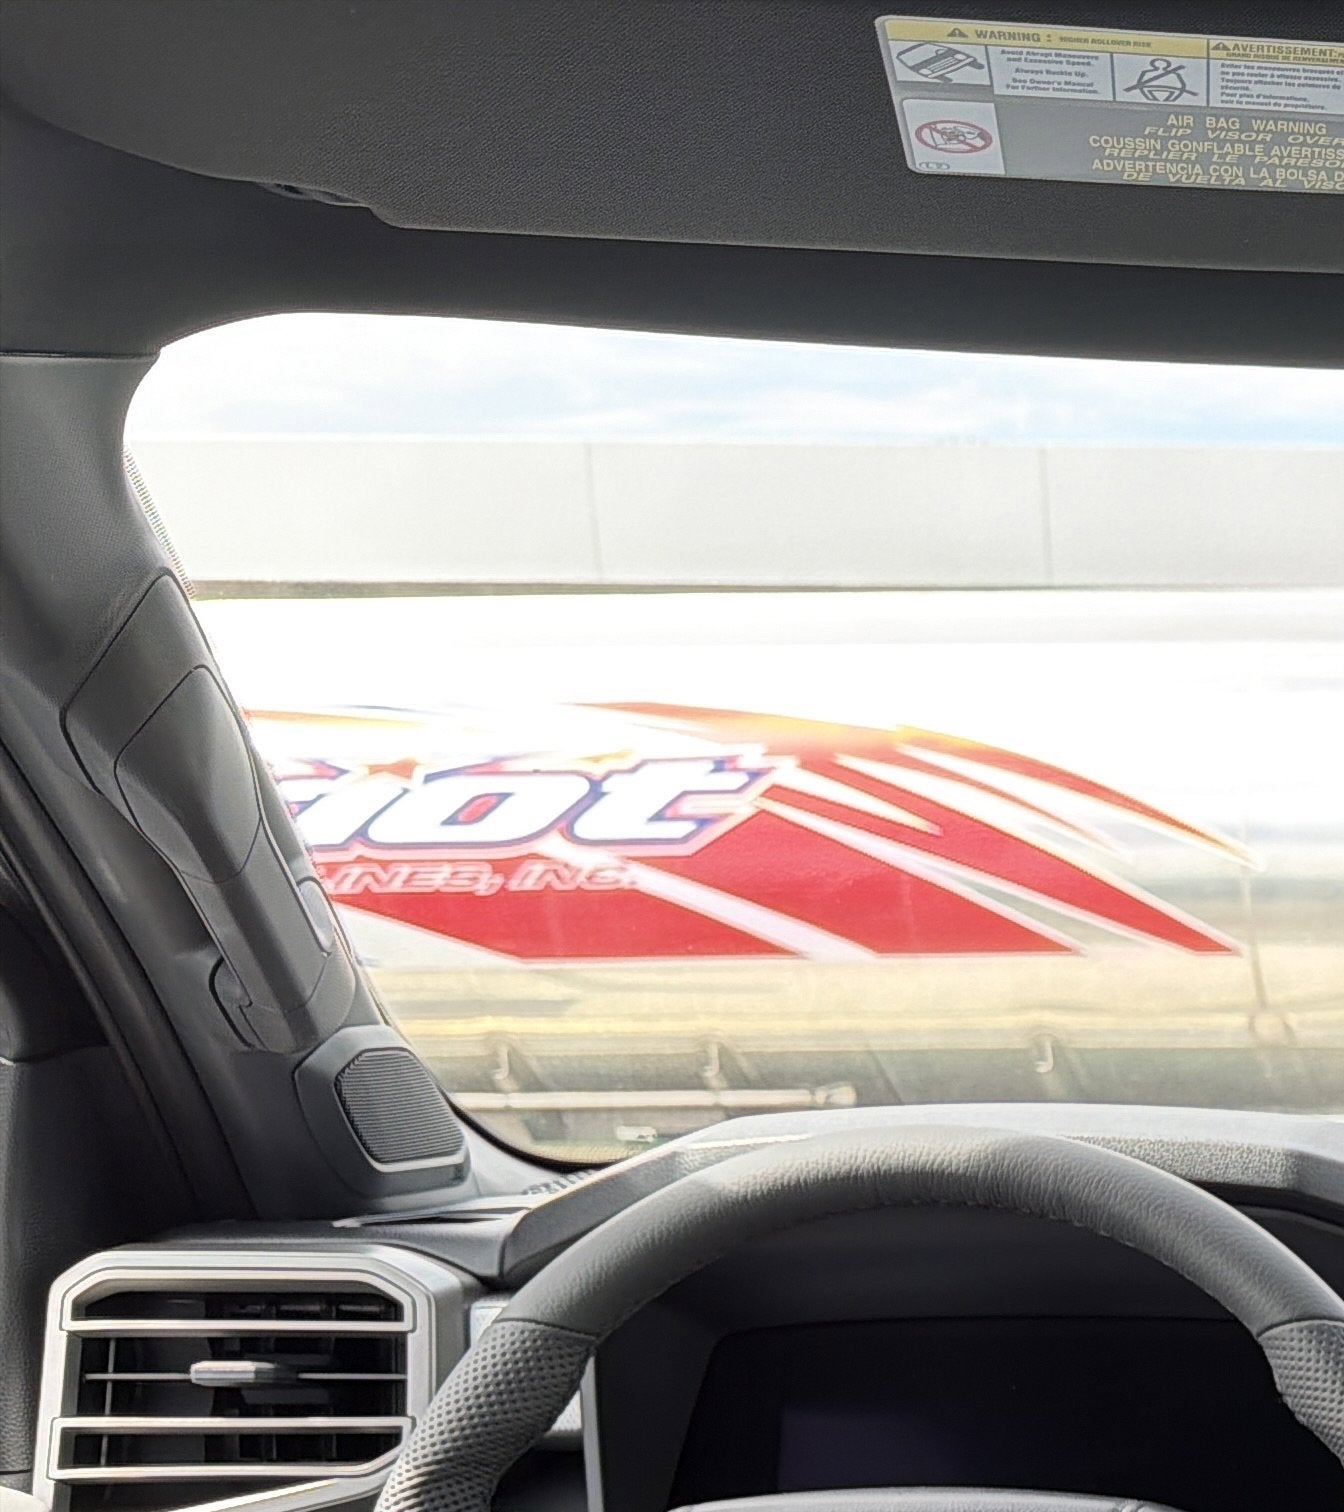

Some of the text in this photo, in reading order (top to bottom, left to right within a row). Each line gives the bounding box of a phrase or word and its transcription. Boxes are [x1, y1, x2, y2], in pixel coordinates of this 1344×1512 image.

[974, 30, 1041, 42] WARNING
[1167, 114, 1327, 135] AIR BAG WARNING
[1144, 127, 1192, 136] FLIP
[1207, 130, 1273, 142] VISOR
[1089, 135, 1161, 150] COUSSIN
[1168, 140, 1265, 156] GONFLABLE
[1104, 148, 1198, 160] REPLIER
[1212, 154, 1240, 163] LE
[1092, 158, 1204, 175] ADVERTENCIA
[1210, 165, 1243, 177] CON
[1251, 167, 1270, 179] LA
[1276, 168, 1328, 182] BOLSA
[1122, 172, 1153, 182] DE
[1168, 174, 1246, 186] VUELTA
[1259, 179, 1287, 188] AL
